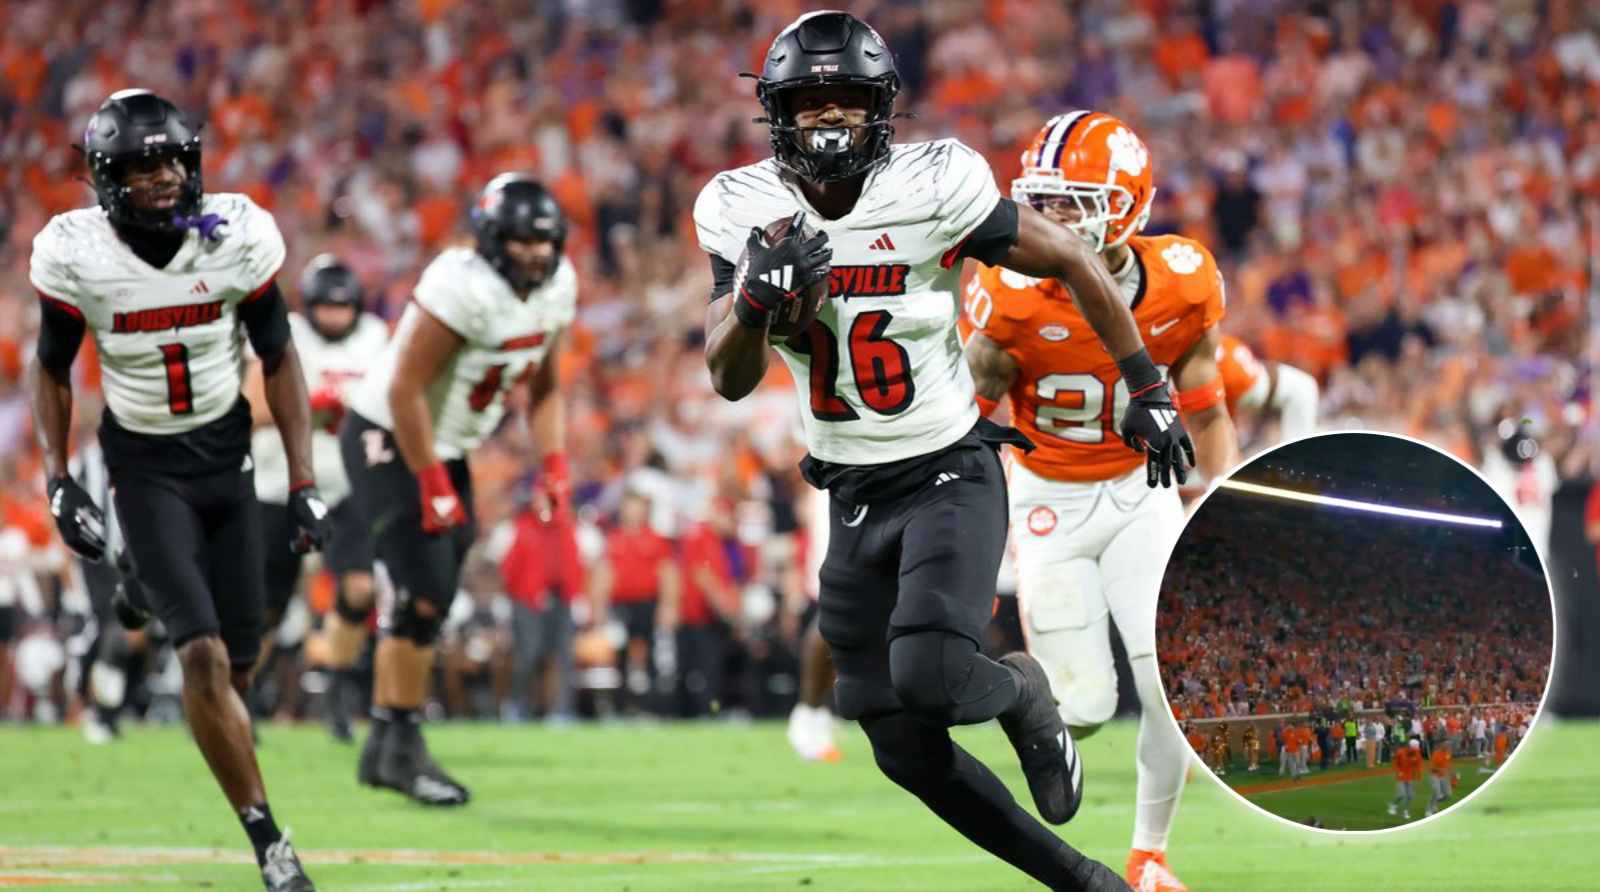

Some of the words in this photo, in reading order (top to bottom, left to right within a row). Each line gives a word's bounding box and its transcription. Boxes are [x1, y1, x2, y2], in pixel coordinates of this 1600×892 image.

[829, 264, 911, 303] SVILLE
[111, 299, 225, 334] LOUISVILLE
[158, 343, 194, 416] 1
[785, 309, 916, 421] 26
